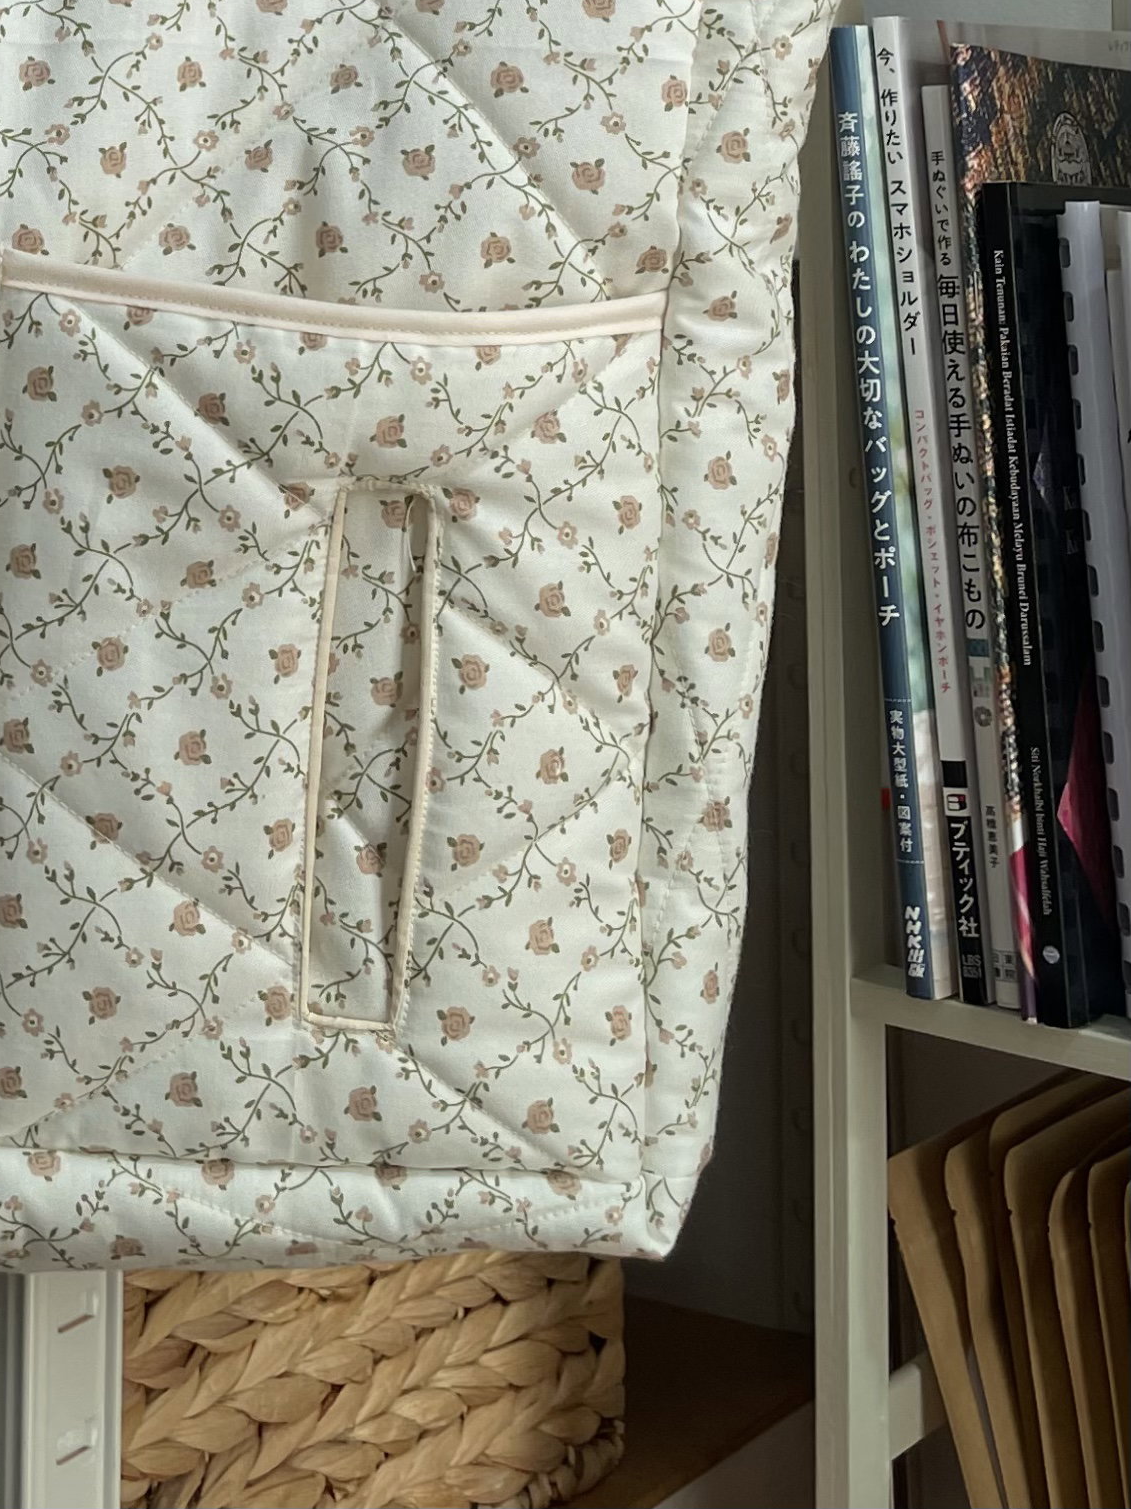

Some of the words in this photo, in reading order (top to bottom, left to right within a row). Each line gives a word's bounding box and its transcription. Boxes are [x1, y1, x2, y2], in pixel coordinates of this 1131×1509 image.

[890, 180, 921, 355] スマホショルダー
[994, 249, 1005, 275] Kain
[999, 327, 1011, 369] Pakaian
[1002, 371, 1015, 412] Beradat
[950, 820, 980, 938] ブティック社
